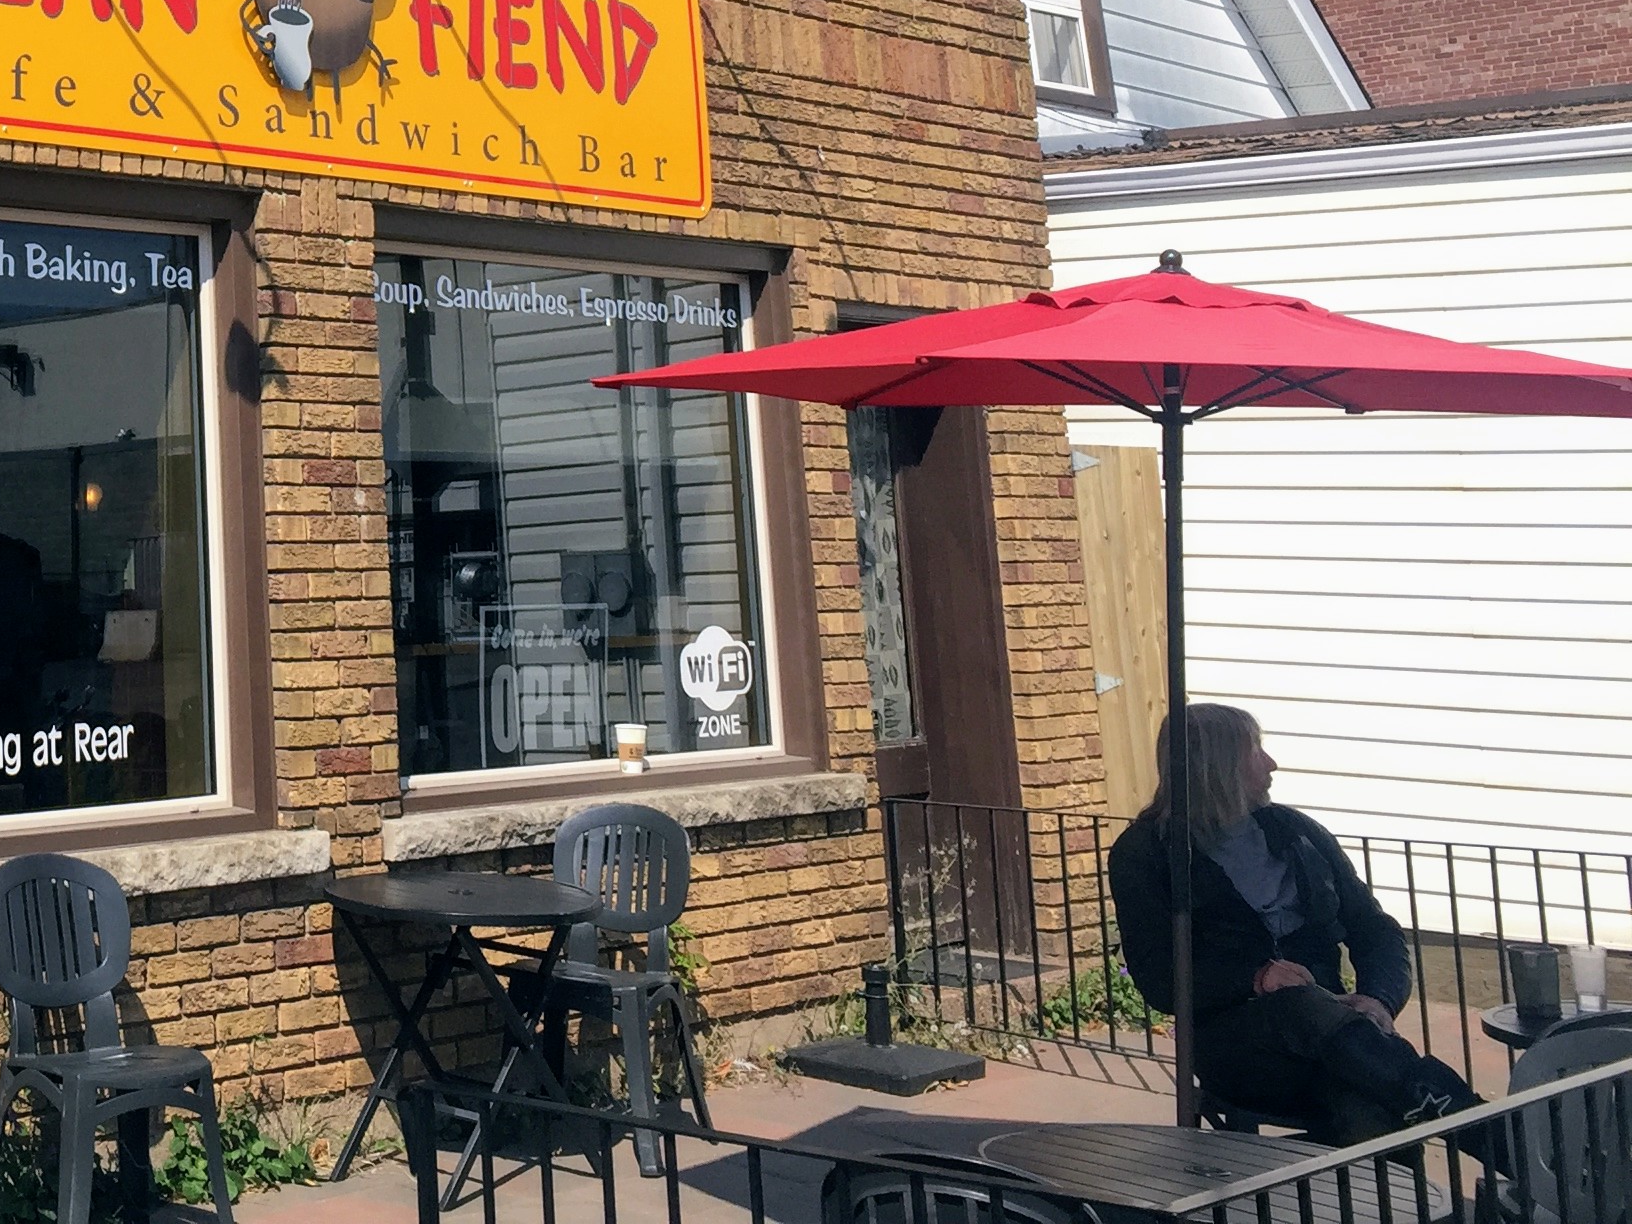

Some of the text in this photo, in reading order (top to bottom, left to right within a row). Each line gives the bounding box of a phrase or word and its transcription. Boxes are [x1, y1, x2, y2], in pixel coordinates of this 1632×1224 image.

[128, 73, 165, 118] &
[218, 86, 540, 167] Sandwich
[579, 134, 670, 182] Bar
[24, 243, 135, 294] Baking,
[144, 252, 193, 290] Tea
[436, 275, 574, 318] Sandwiches,
[580, 287, 667, 326] Espresso
[673, 294, 737, 328] Drinks
[490, 664, 601, 753] OPEN
[698, 714, 742, 738] ZONE
[33, 725, 62, 766] at
[74, 722, 134, 764] Rear
